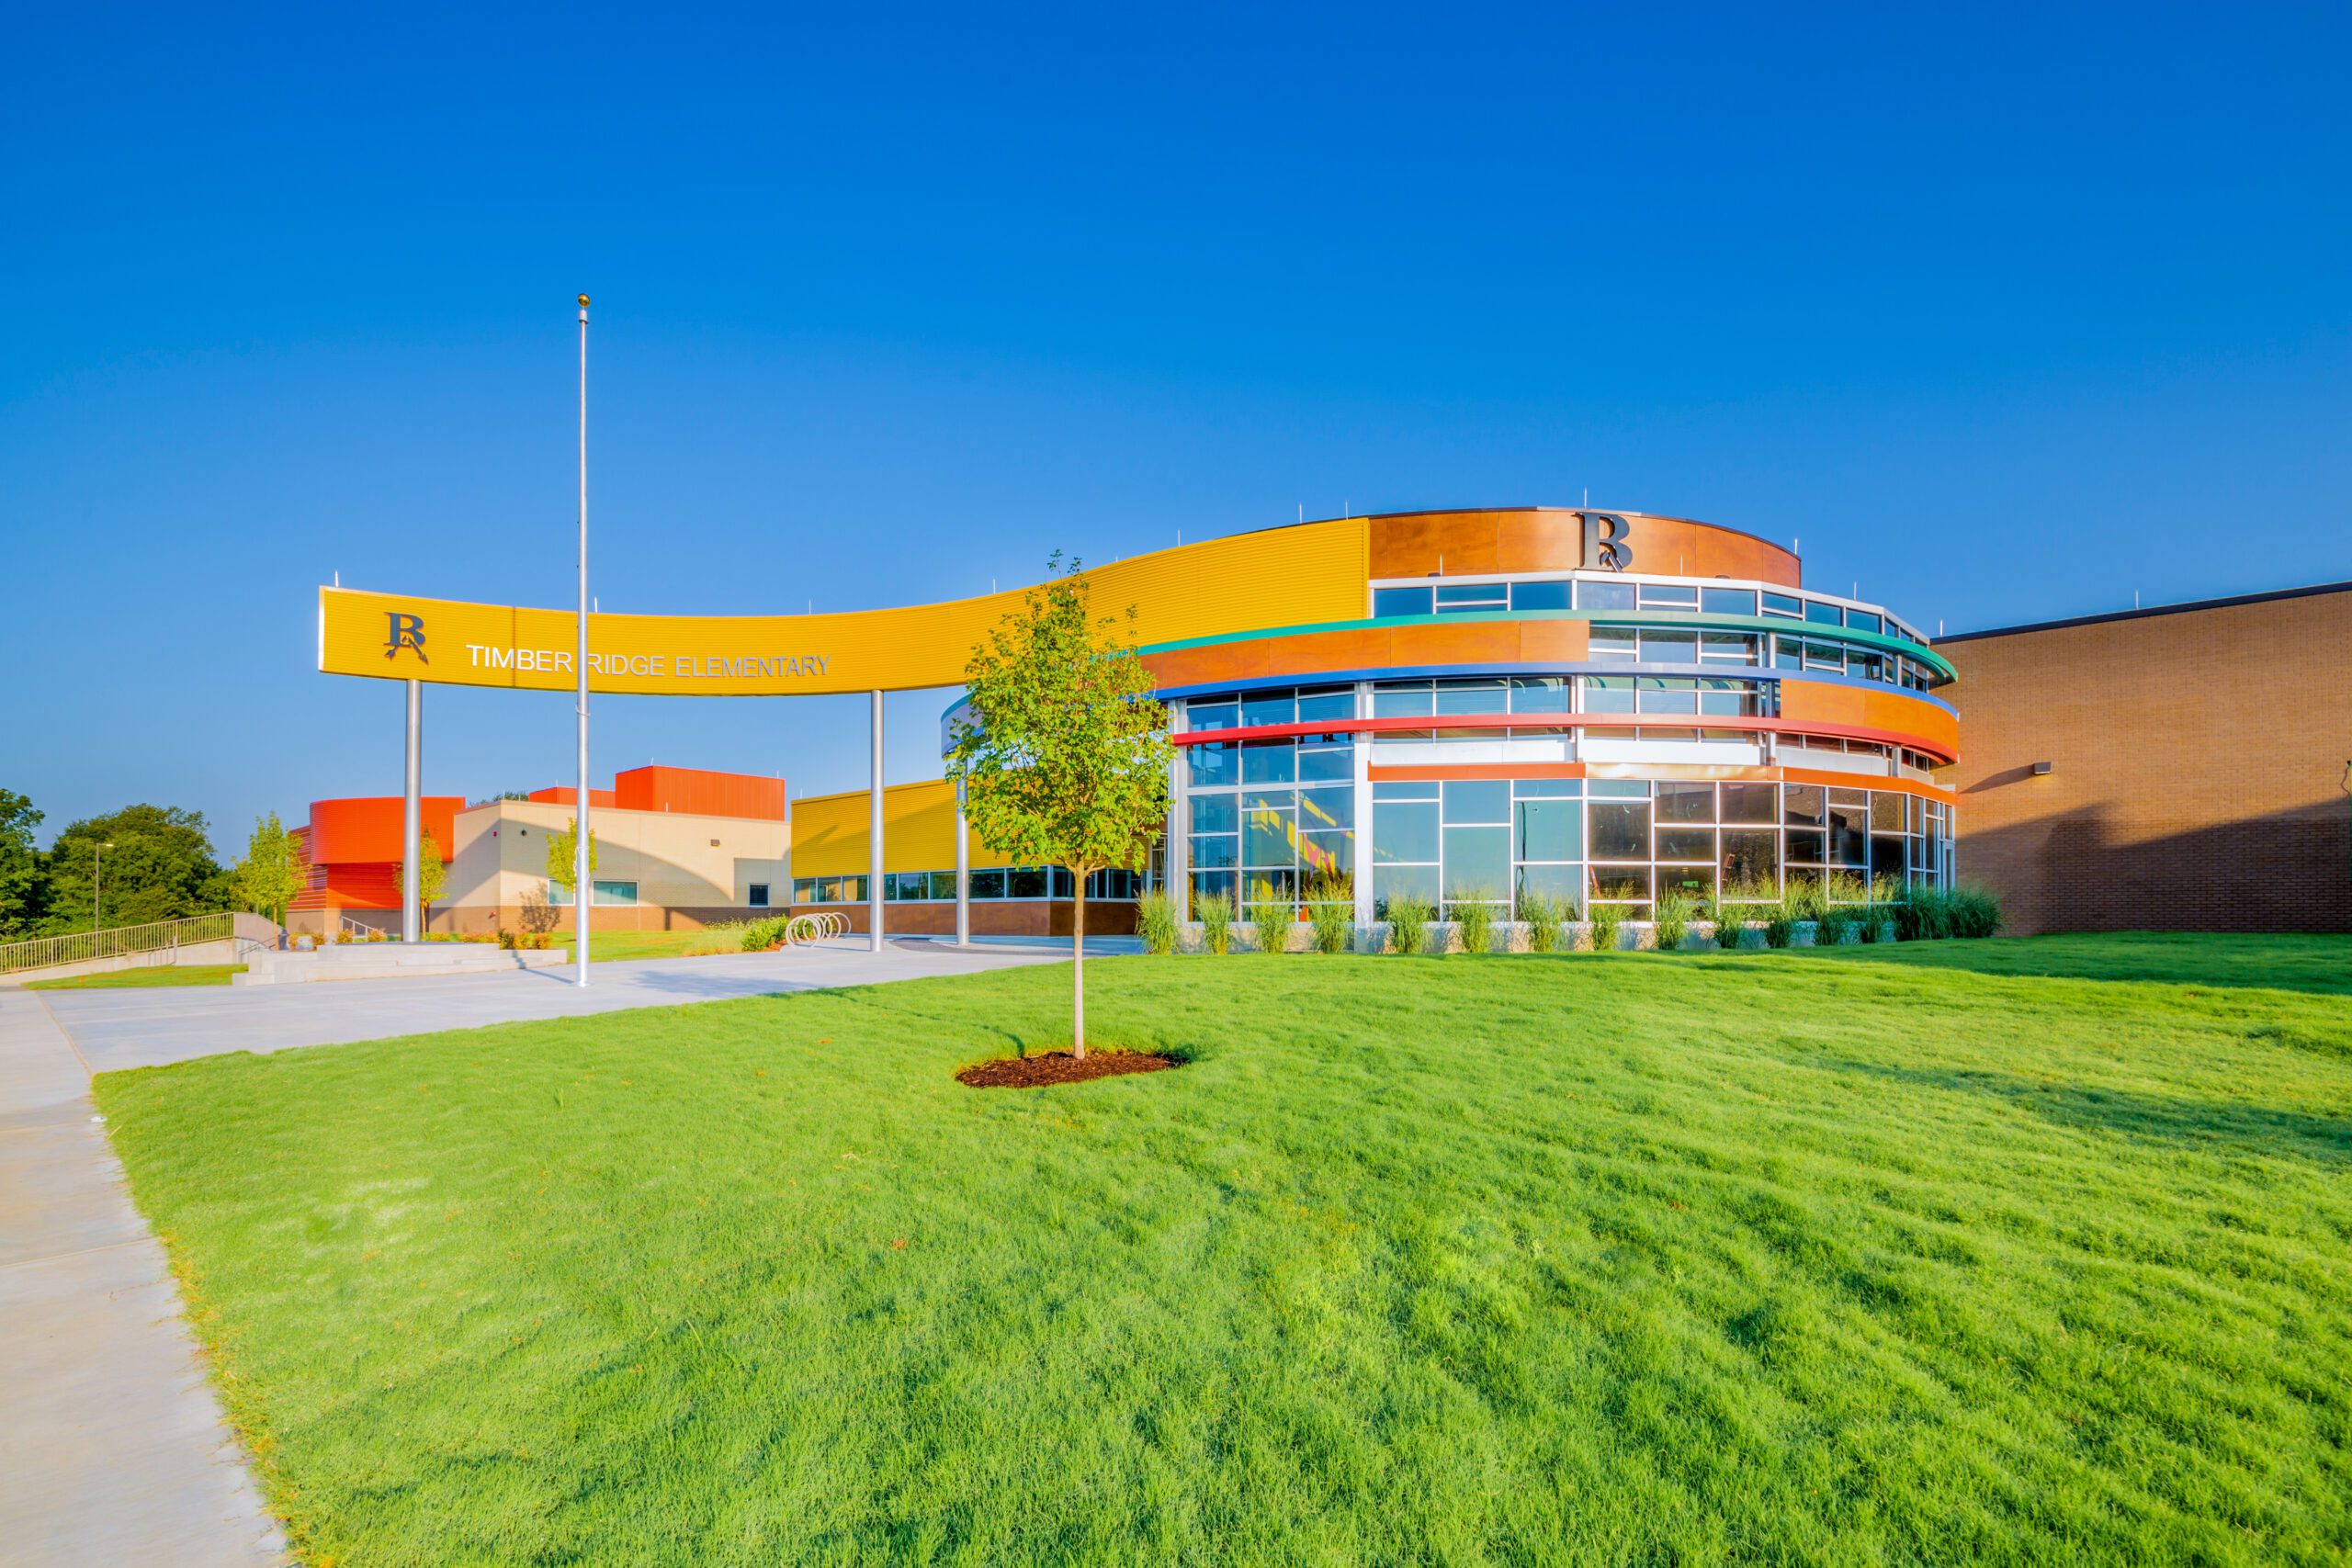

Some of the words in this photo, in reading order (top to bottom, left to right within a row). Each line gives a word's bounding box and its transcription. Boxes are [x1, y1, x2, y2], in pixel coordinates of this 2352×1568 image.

[466, 644, 573, 673] TIMBER
[587, 653, 665, 677] RIDGE
[675, 654, 831, 678] ELEMENTARY
